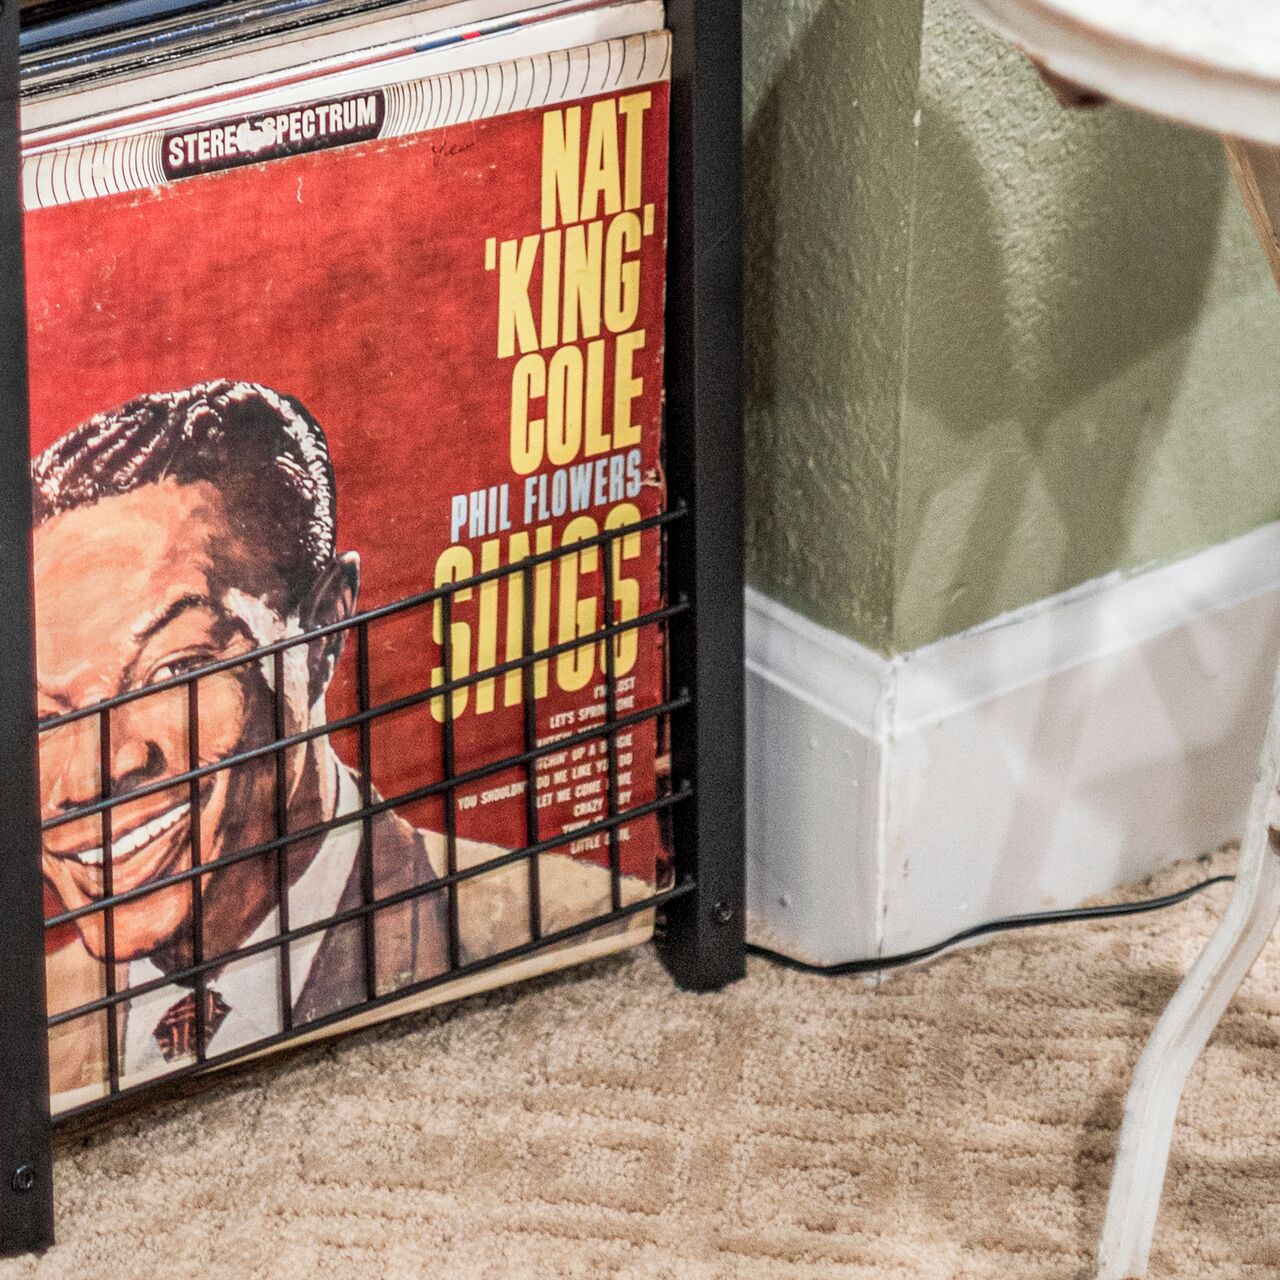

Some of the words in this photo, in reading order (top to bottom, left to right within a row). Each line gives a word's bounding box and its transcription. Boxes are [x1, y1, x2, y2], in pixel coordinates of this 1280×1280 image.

[540, 91, 652, 230] NAT
[484, 203, 655, 359] 'KING'
[509, 329, 646, 475] COLE
[450, 486, 512, 543] PHIL
[523, 449, 642, 525] FLOWERS
[430, 503, 641, 724] SINGS
[457, 795, 478, 810] YOU
[573, 797, 604, 817] CRAZY
